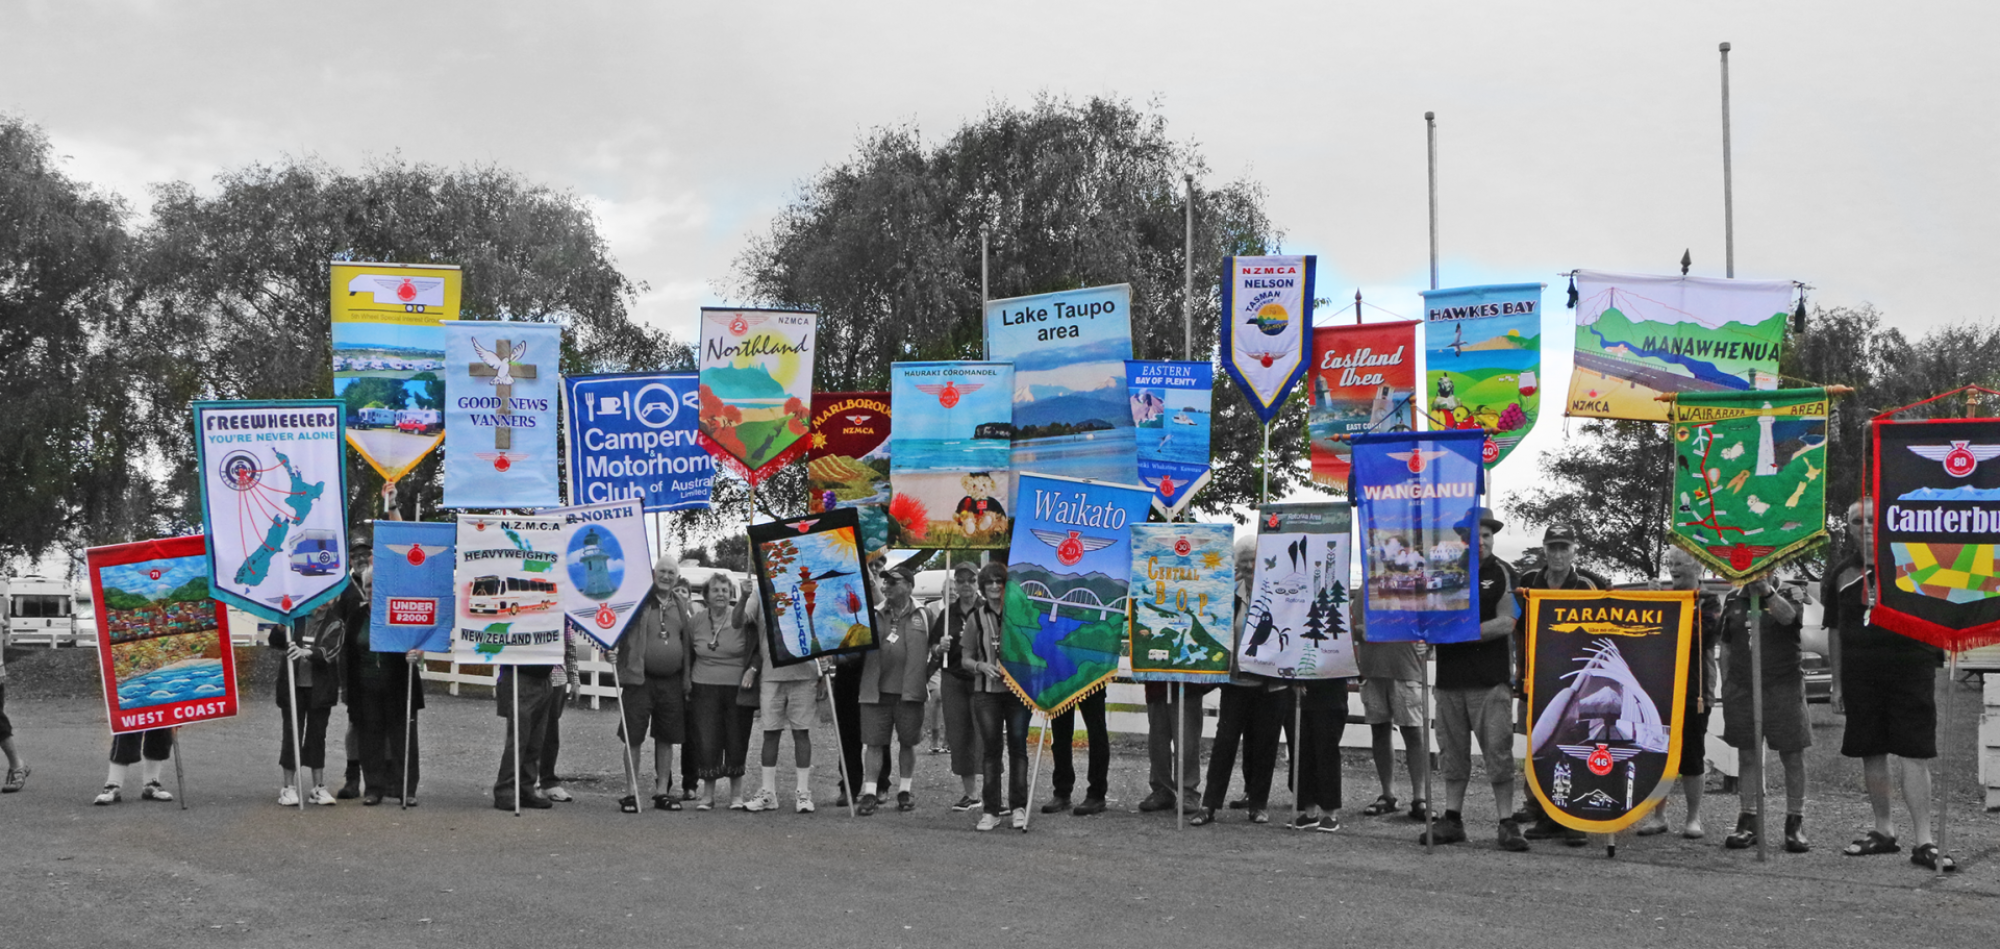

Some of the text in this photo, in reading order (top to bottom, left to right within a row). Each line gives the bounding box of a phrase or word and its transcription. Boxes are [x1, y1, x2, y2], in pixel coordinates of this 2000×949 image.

[1245, 279, 1294, 288] NELSON
[1245, 291, 1281, 312] TASMAN
[380, 314, 402, 322] Special
[1002, 300, 1115, 326] Lake Taupo
[1429, 300, 1537, 321] HAWKES BAY
[734, 322, 743, 331] 2
[778, 317, 809, 325] NZMCA
[1037, 323, 1080, 342] area
[706, 333, 809, 362] Northland
[1642, 335, 1780, 363] MANAWHENUA
[1320, 345, 1405, 370] Eastland
[1142, 366, 1192, 377] EASTERN
[1339, 367, 1385, 388] Area
[1135, 376, 1151, 384] BAY
[1165, 378, 1197, 387] PLENTY
[457, 396, 548, 411] GOOD NEWS
[1572, 400, 1610, 413] NZMCA
[1677, 402, 1825, 422] WAIRARAPA AREA
[206, 413, 335, 430] FREEWHEELERS
[470, 414, 536, 428] VANNERS
[1346, 423, 1362, 431] EAST
[208, 431, 336, 444] YOU'RE NEVER ALONE
[584, 428, 699, 454] Camperv
[650, 450, 656, 458] &
[1482, 448, 1494, 456] 40
[586, 453, 719, 478] Motorhome
[1954, 457, 1967, 467] 80
[588, 476, 714, 503] Club of Austral
[680, 488, 708, 498] Limited
[1363, 482, 1475, 500] WANGANUI
[580, 506, 634, 522] NORTH
[1034, 489, 1127, 530] Waikato
[500, 521, 561, 531] N.Z.M.C.A
[464, 548, 559, 564] HEAVYWEIGHTS
[1066, 547, 1076, 555] 20
[392, 601, 434, 612] UNDER
[396, 612, 428, 623] #2000
[602, 612, 608, 622] 1
[790, 584, 808, 656] AUCKLAND
[1554, 607, 1663, 624] TARANAKI
[461, 628, 560, 645] NEW ZEALAND WIDE
[120, 702, 227, 728] WEST COAST
[1594, 757, 1608, 767] 46
